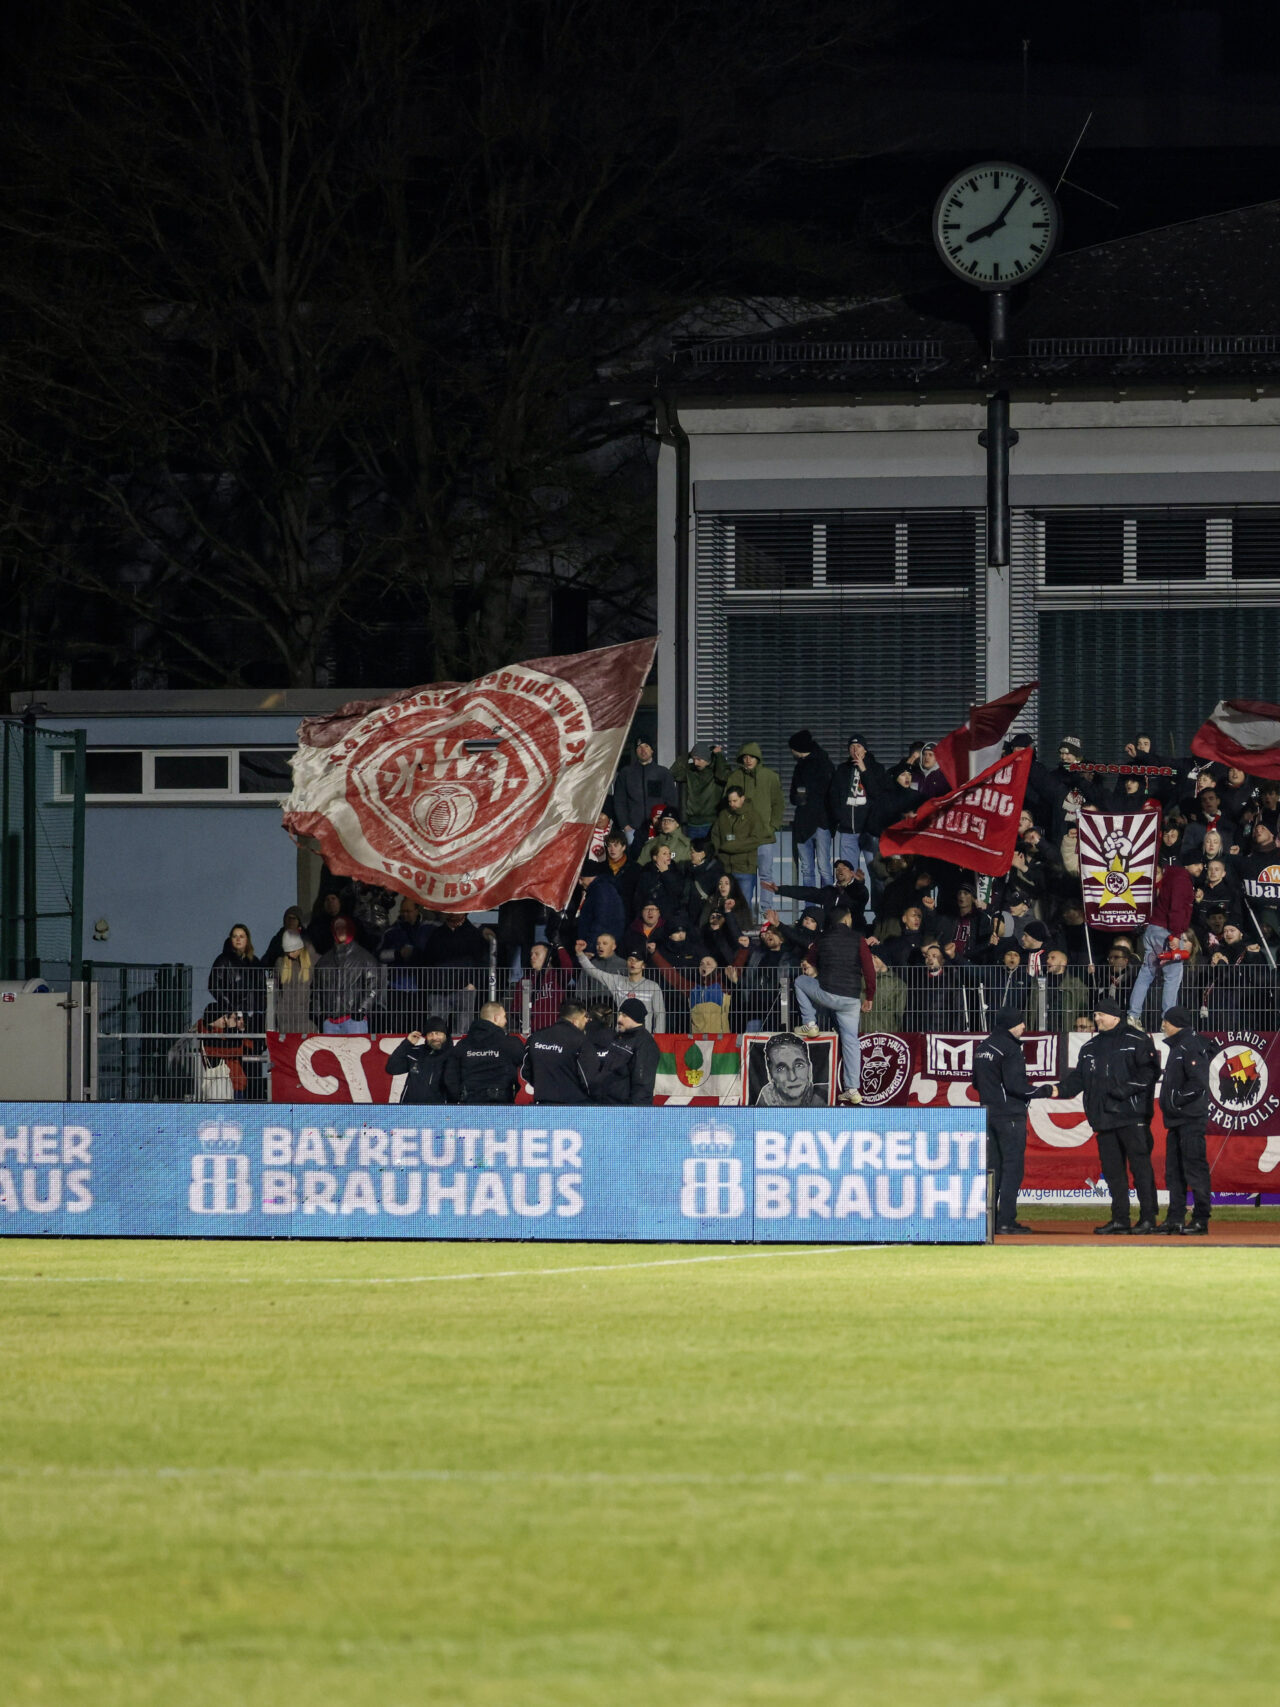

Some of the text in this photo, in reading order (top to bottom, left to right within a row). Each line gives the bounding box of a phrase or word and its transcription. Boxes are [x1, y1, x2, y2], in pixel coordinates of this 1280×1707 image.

[1069, 763, 1173, 776] AUGSBURG
[1090, 914, 1146, 924] ULTRAS
[534, 1042, 563, 1053] Security
[873, 1037, 887, 1046] DIE
[1228, 1031, 1267, 1050] BANDE
[467, 1050, 500, 1058] Security
[1208, 1094, 1280, 1130] ERBIPOLIS
[261, 1126, 583, 1168] BAYREUTHER
[755, 1130, 987, 1171] BAYREUT
[261, 1170, 584, 1217] BRAUHAUS
